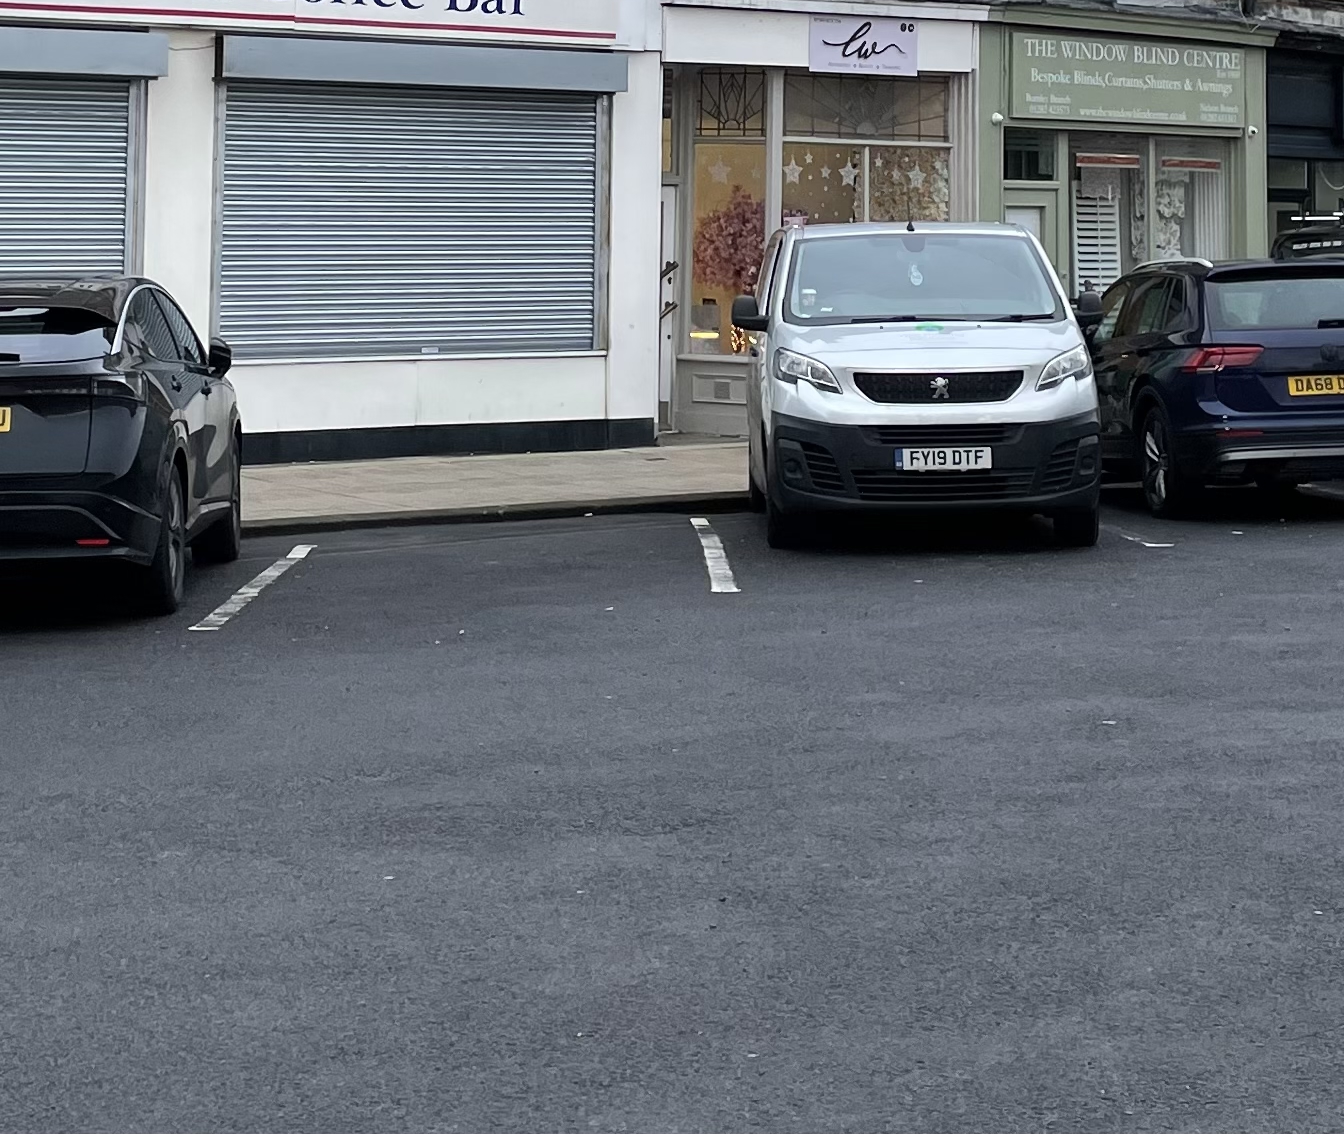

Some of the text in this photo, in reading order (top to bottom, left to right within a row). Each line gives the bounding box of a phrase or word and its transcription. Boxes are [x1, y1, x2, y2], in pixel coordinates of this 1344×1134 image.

[1024, 38, 1241, 70] THE WINDOW BLIND CENTRE
[1031, 67, 1072, 88] Bespoke
[1183, 78, 1193, 92] &
[1196, 78, 1233, 98] Awnings
[1295, 377, 1333, 392] DA68
[910, 449, 984, 466] FY19 DTF
